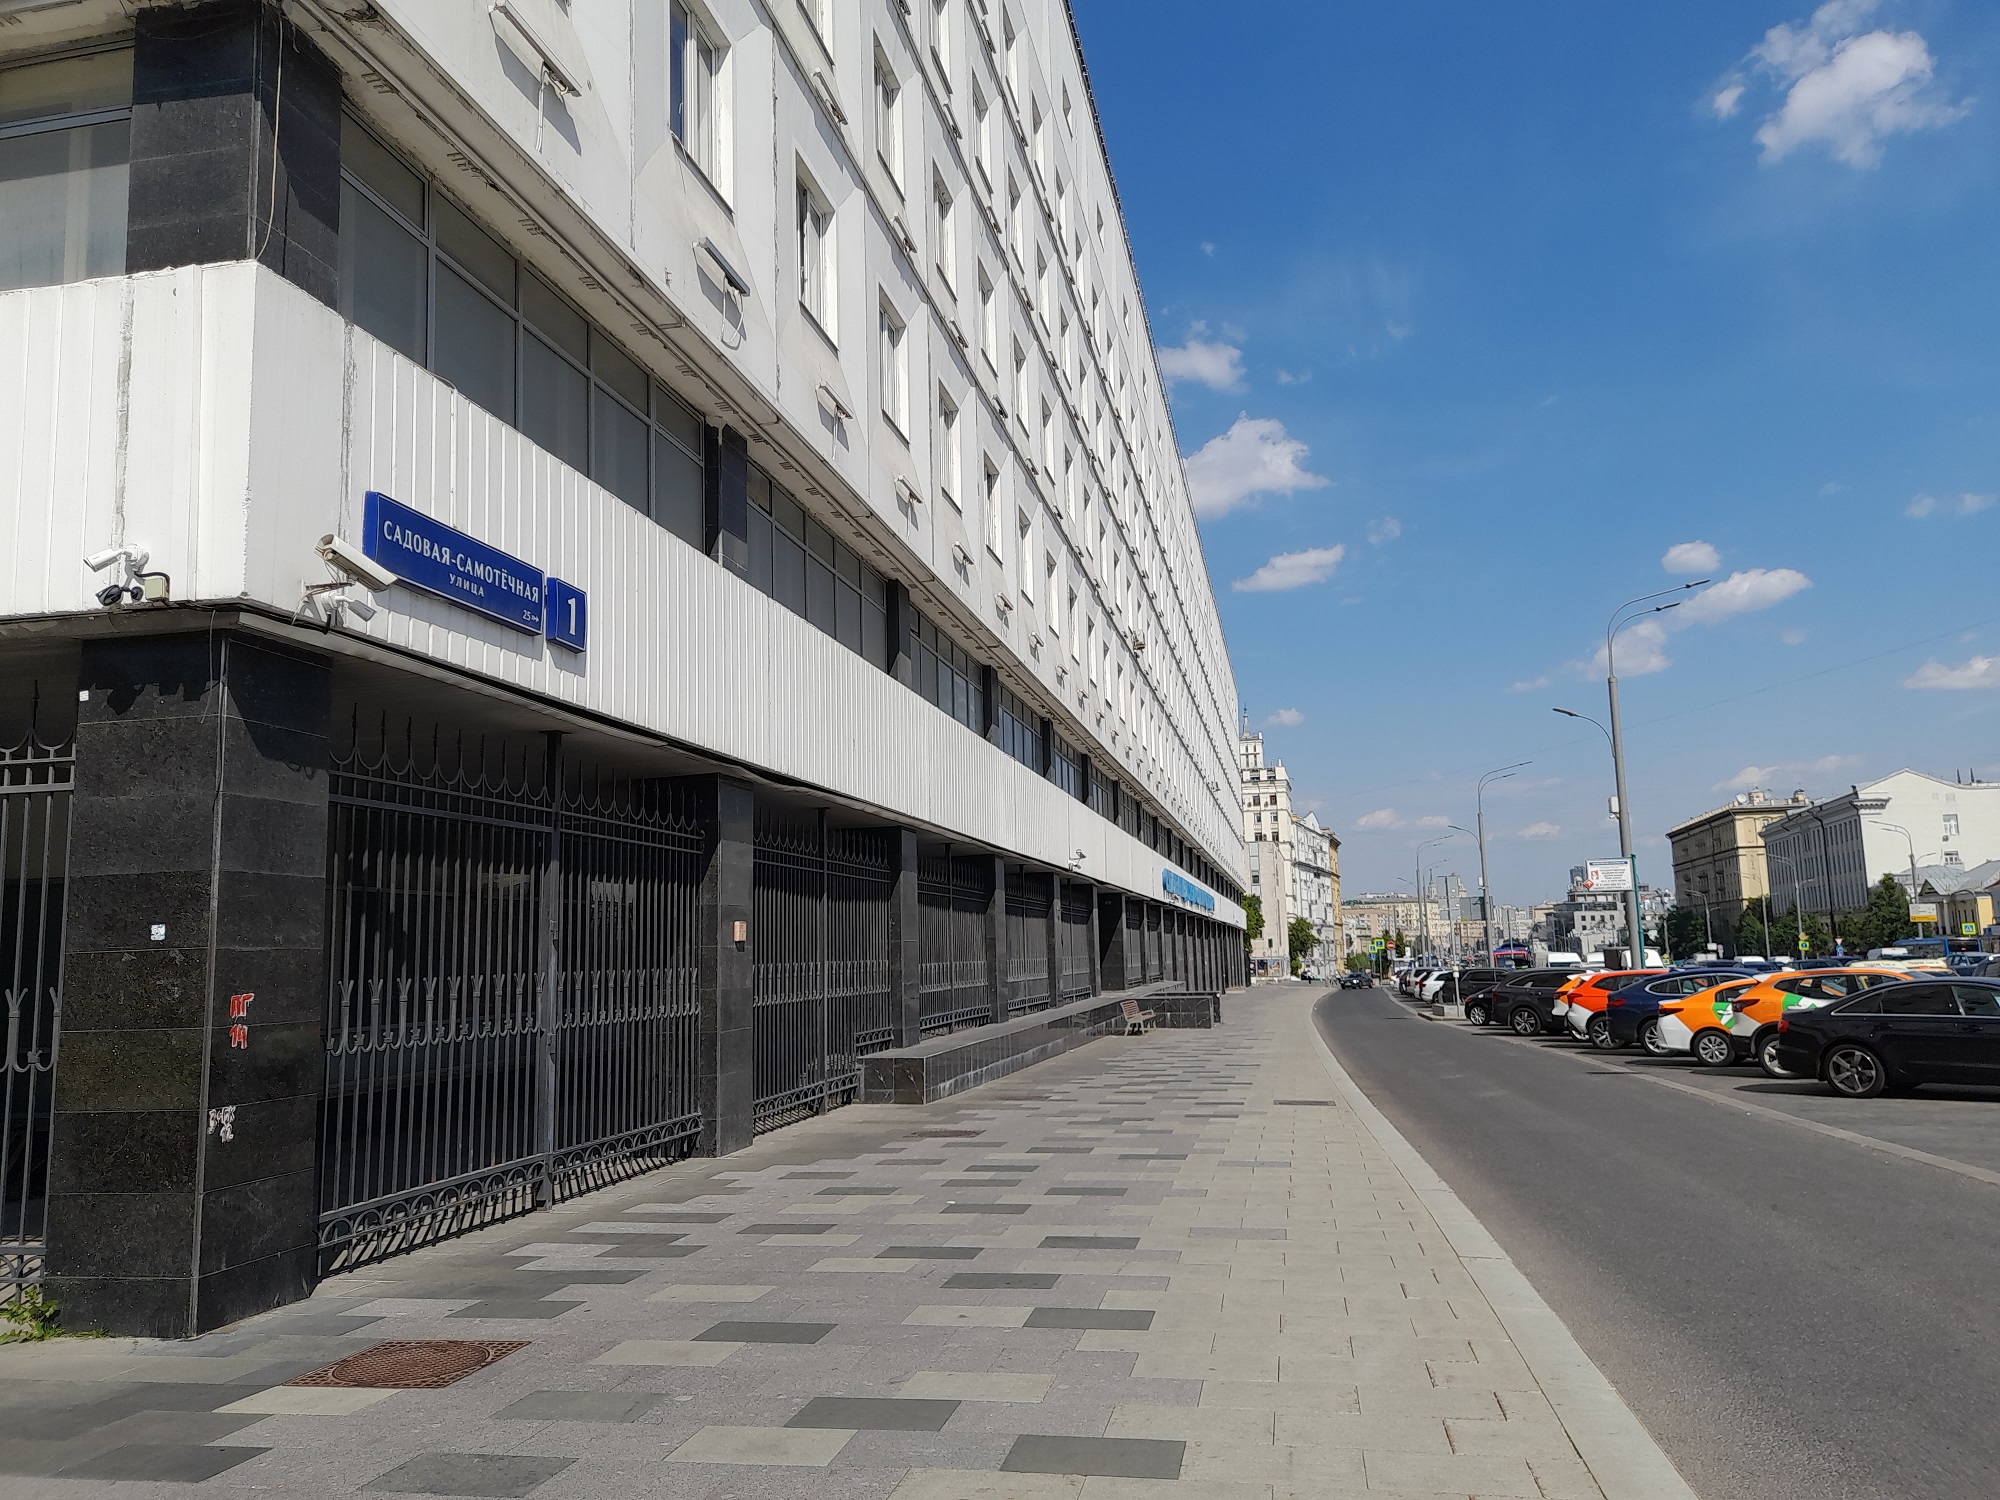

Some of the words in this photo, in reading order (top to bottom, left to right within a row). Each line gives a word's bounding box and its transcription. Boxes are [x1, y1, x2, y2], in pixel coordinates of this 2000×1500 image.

[383, 520, 539, 603] САДОВАЯ-САМОТЁЧНАЯ
[449, 573, 485, 597] УЛИЦА
[567, 597, 576, 635] 1
